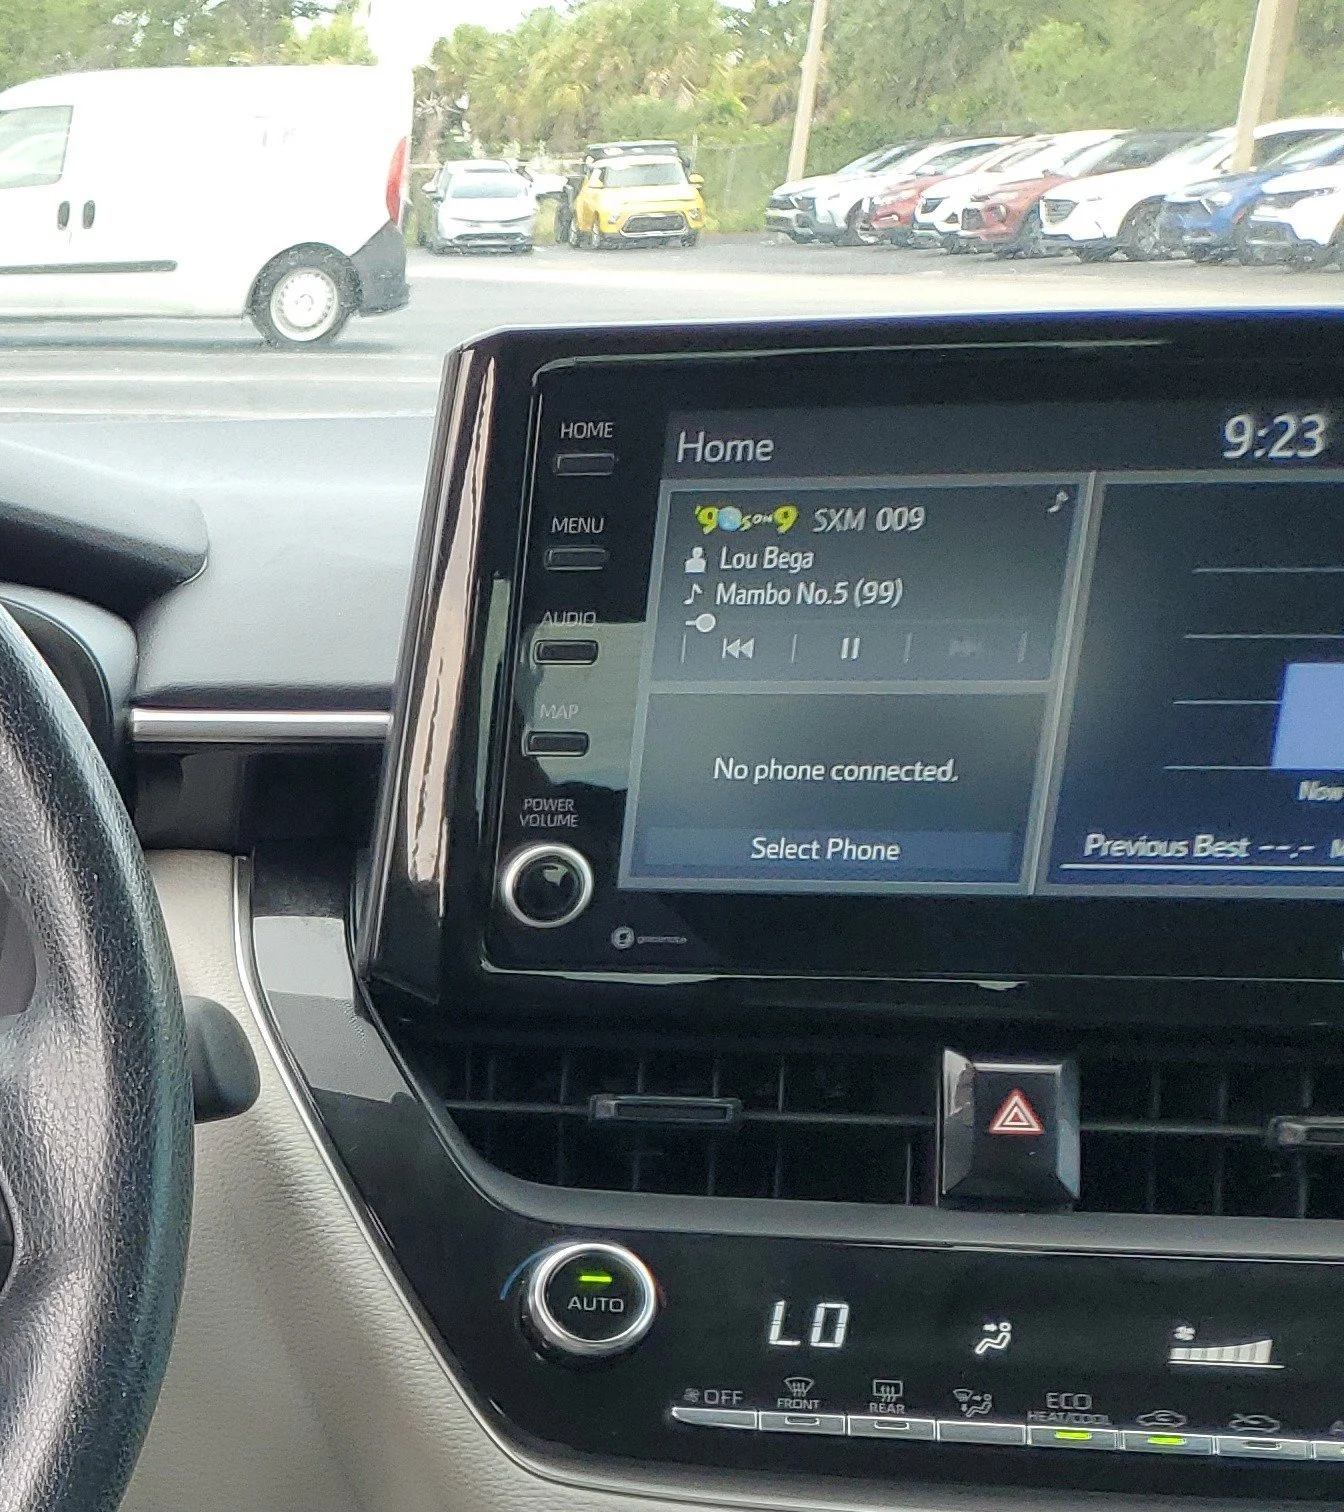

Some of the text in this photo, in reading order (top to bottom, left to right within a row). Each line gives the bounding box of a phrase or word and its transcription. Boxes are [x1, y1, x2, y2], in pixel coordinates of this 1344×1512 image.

[560, 422, 614, 439] HOME
[1223, 413, 1327, 459] 9:23
[676, 430, 774, 463] Home
[551, 517, 605, 534] MENU
[812, 506, 867, 533] SXM
[875, 505, 927, 533] 009
[719, 545, 815, 574] Lou Bega
[715, 577, 904, 609] Mambo No.5 (99)
[541, 611, 597, 627] AUDIO
[539, 703, 579, 720] MAP
[713, 756, 959, 785] No phone connected.
[524, 798, 574, 812] POWER
[519, 813, 580, 828] VOLUME
[750, 837, 901, 862] Select Phone
[1083, 832, 1189, 858] Previous
[1192, 833, 1252, 858] Best
[566, 1295, 624, 1314] AUTO
[704, 1390, 743, 1405] OFF
[777, 1398, 820, 1410] FRONT
[1046, 1392, 1092, 1411] ECO
[869, 1402, 906, 1415] REAR
